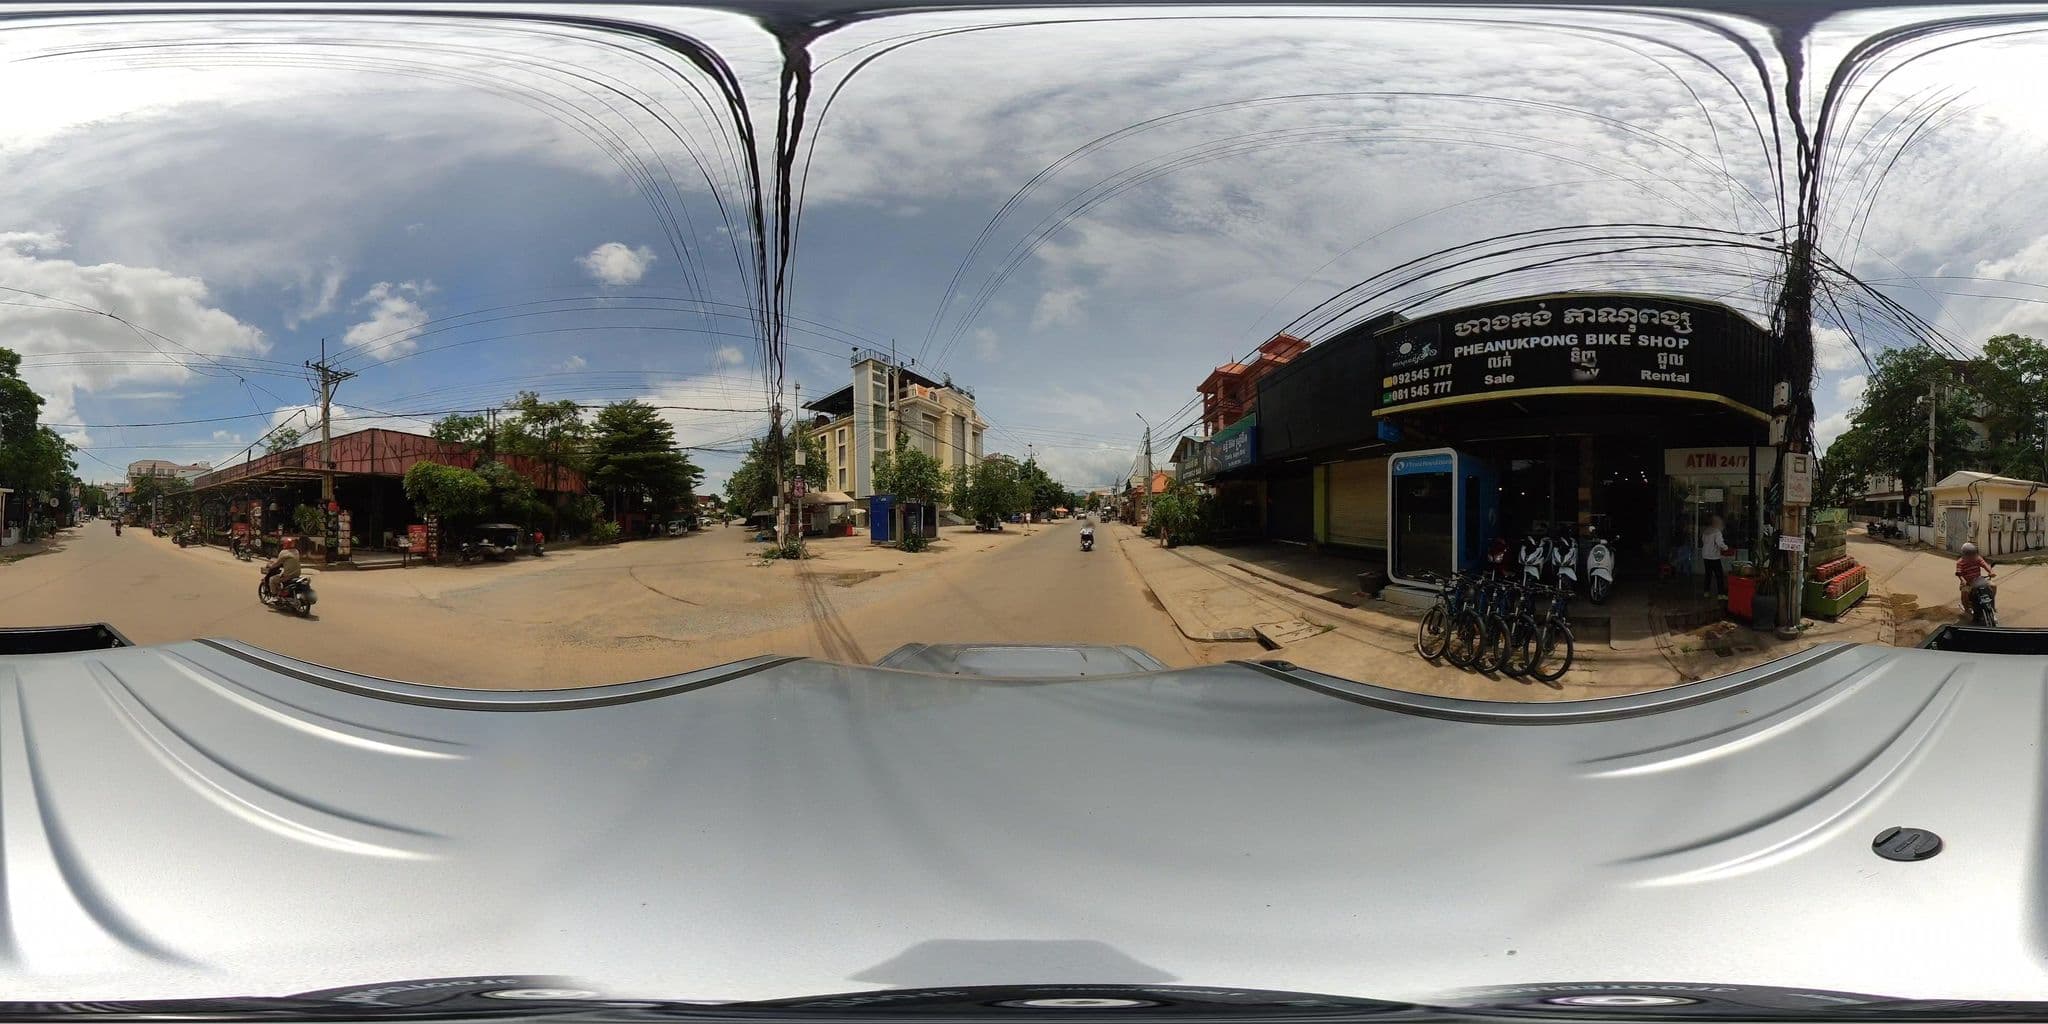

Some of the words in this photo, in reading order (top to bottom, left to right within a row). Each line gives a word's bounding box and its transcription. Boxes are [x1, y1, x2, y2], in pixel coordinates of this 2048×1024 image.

[1454, 334, 1579, 358] PHEANUKPONG
[1585, 333, 1632, 346] BIKE
[1638, 335, 1690, 349] SHOP
[1433, 364, 1453, 378] 777
[1641, 369, 1690, 383] Rental
[1484, 374, 1515, 385] Sale
[1392, 388, 1409, 401] 081
[1410, 384, 1430, 398] 545
[1433, 381, 1453, 394] 777
[1686, 453, 1718, 468] ATM
[1720, 456, 1748, 468] 24/7
